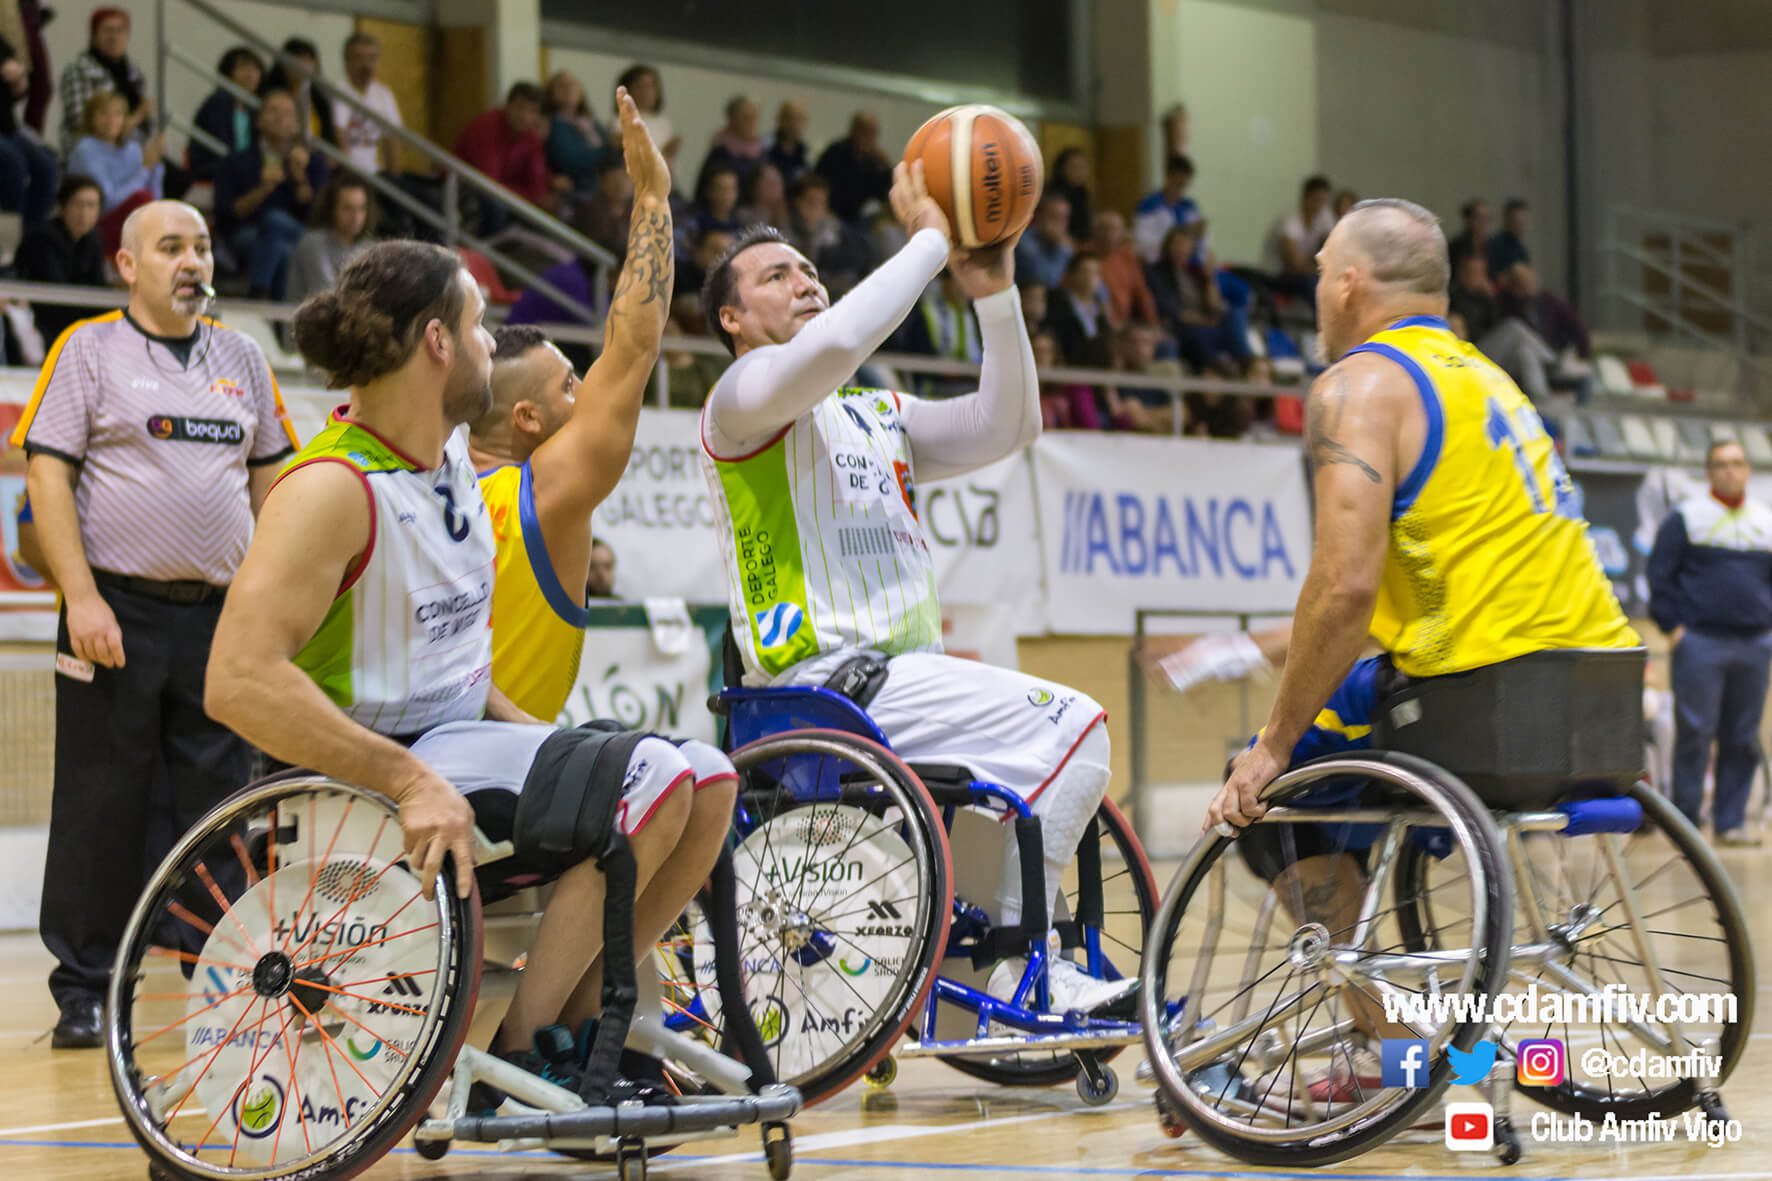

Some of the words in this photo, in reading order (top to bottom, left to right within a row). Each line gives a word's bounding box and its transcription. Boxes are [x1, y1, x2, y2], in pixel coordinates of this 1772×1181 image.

[983, 143, 1002, 223] molten
[185, 417, 241, 442] bequal
[738, 527, 766, 606] DEPORTE
[756, 530, 779, 600] GALEGO
[297, 1093, 368, 1124] Amfi
